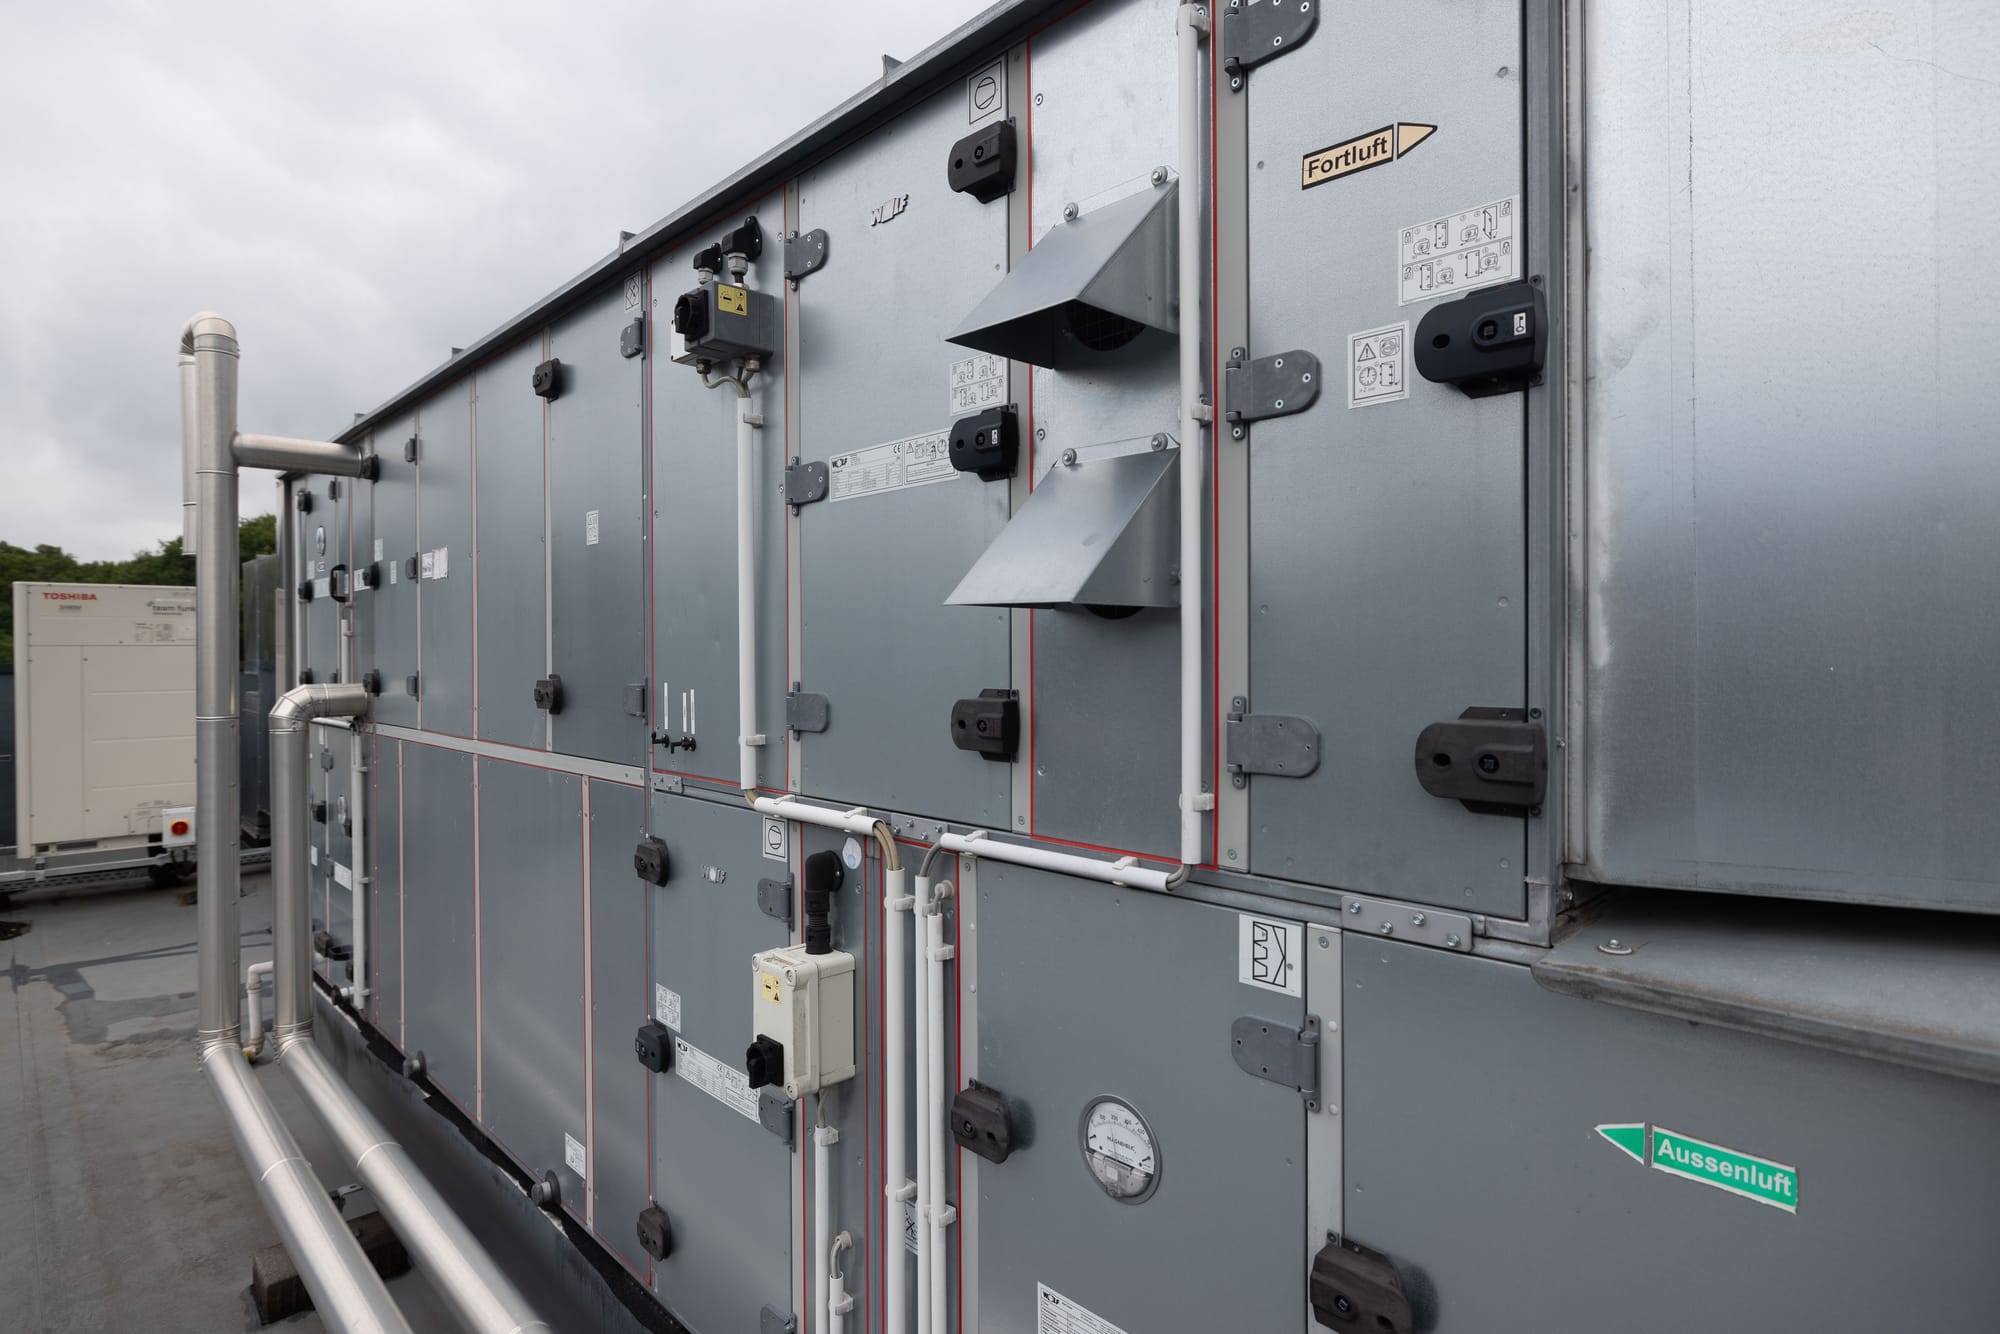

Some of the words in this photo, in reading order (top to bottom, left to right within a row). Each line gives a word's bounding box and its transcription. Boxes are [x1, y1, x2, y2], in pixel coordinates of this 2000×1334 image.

[1308, 136, 1388, 178] Fortluft
[42, 592, 97, 600] TOSHIBA
[1658, 1138, 1792, 1196] Aussenluft
